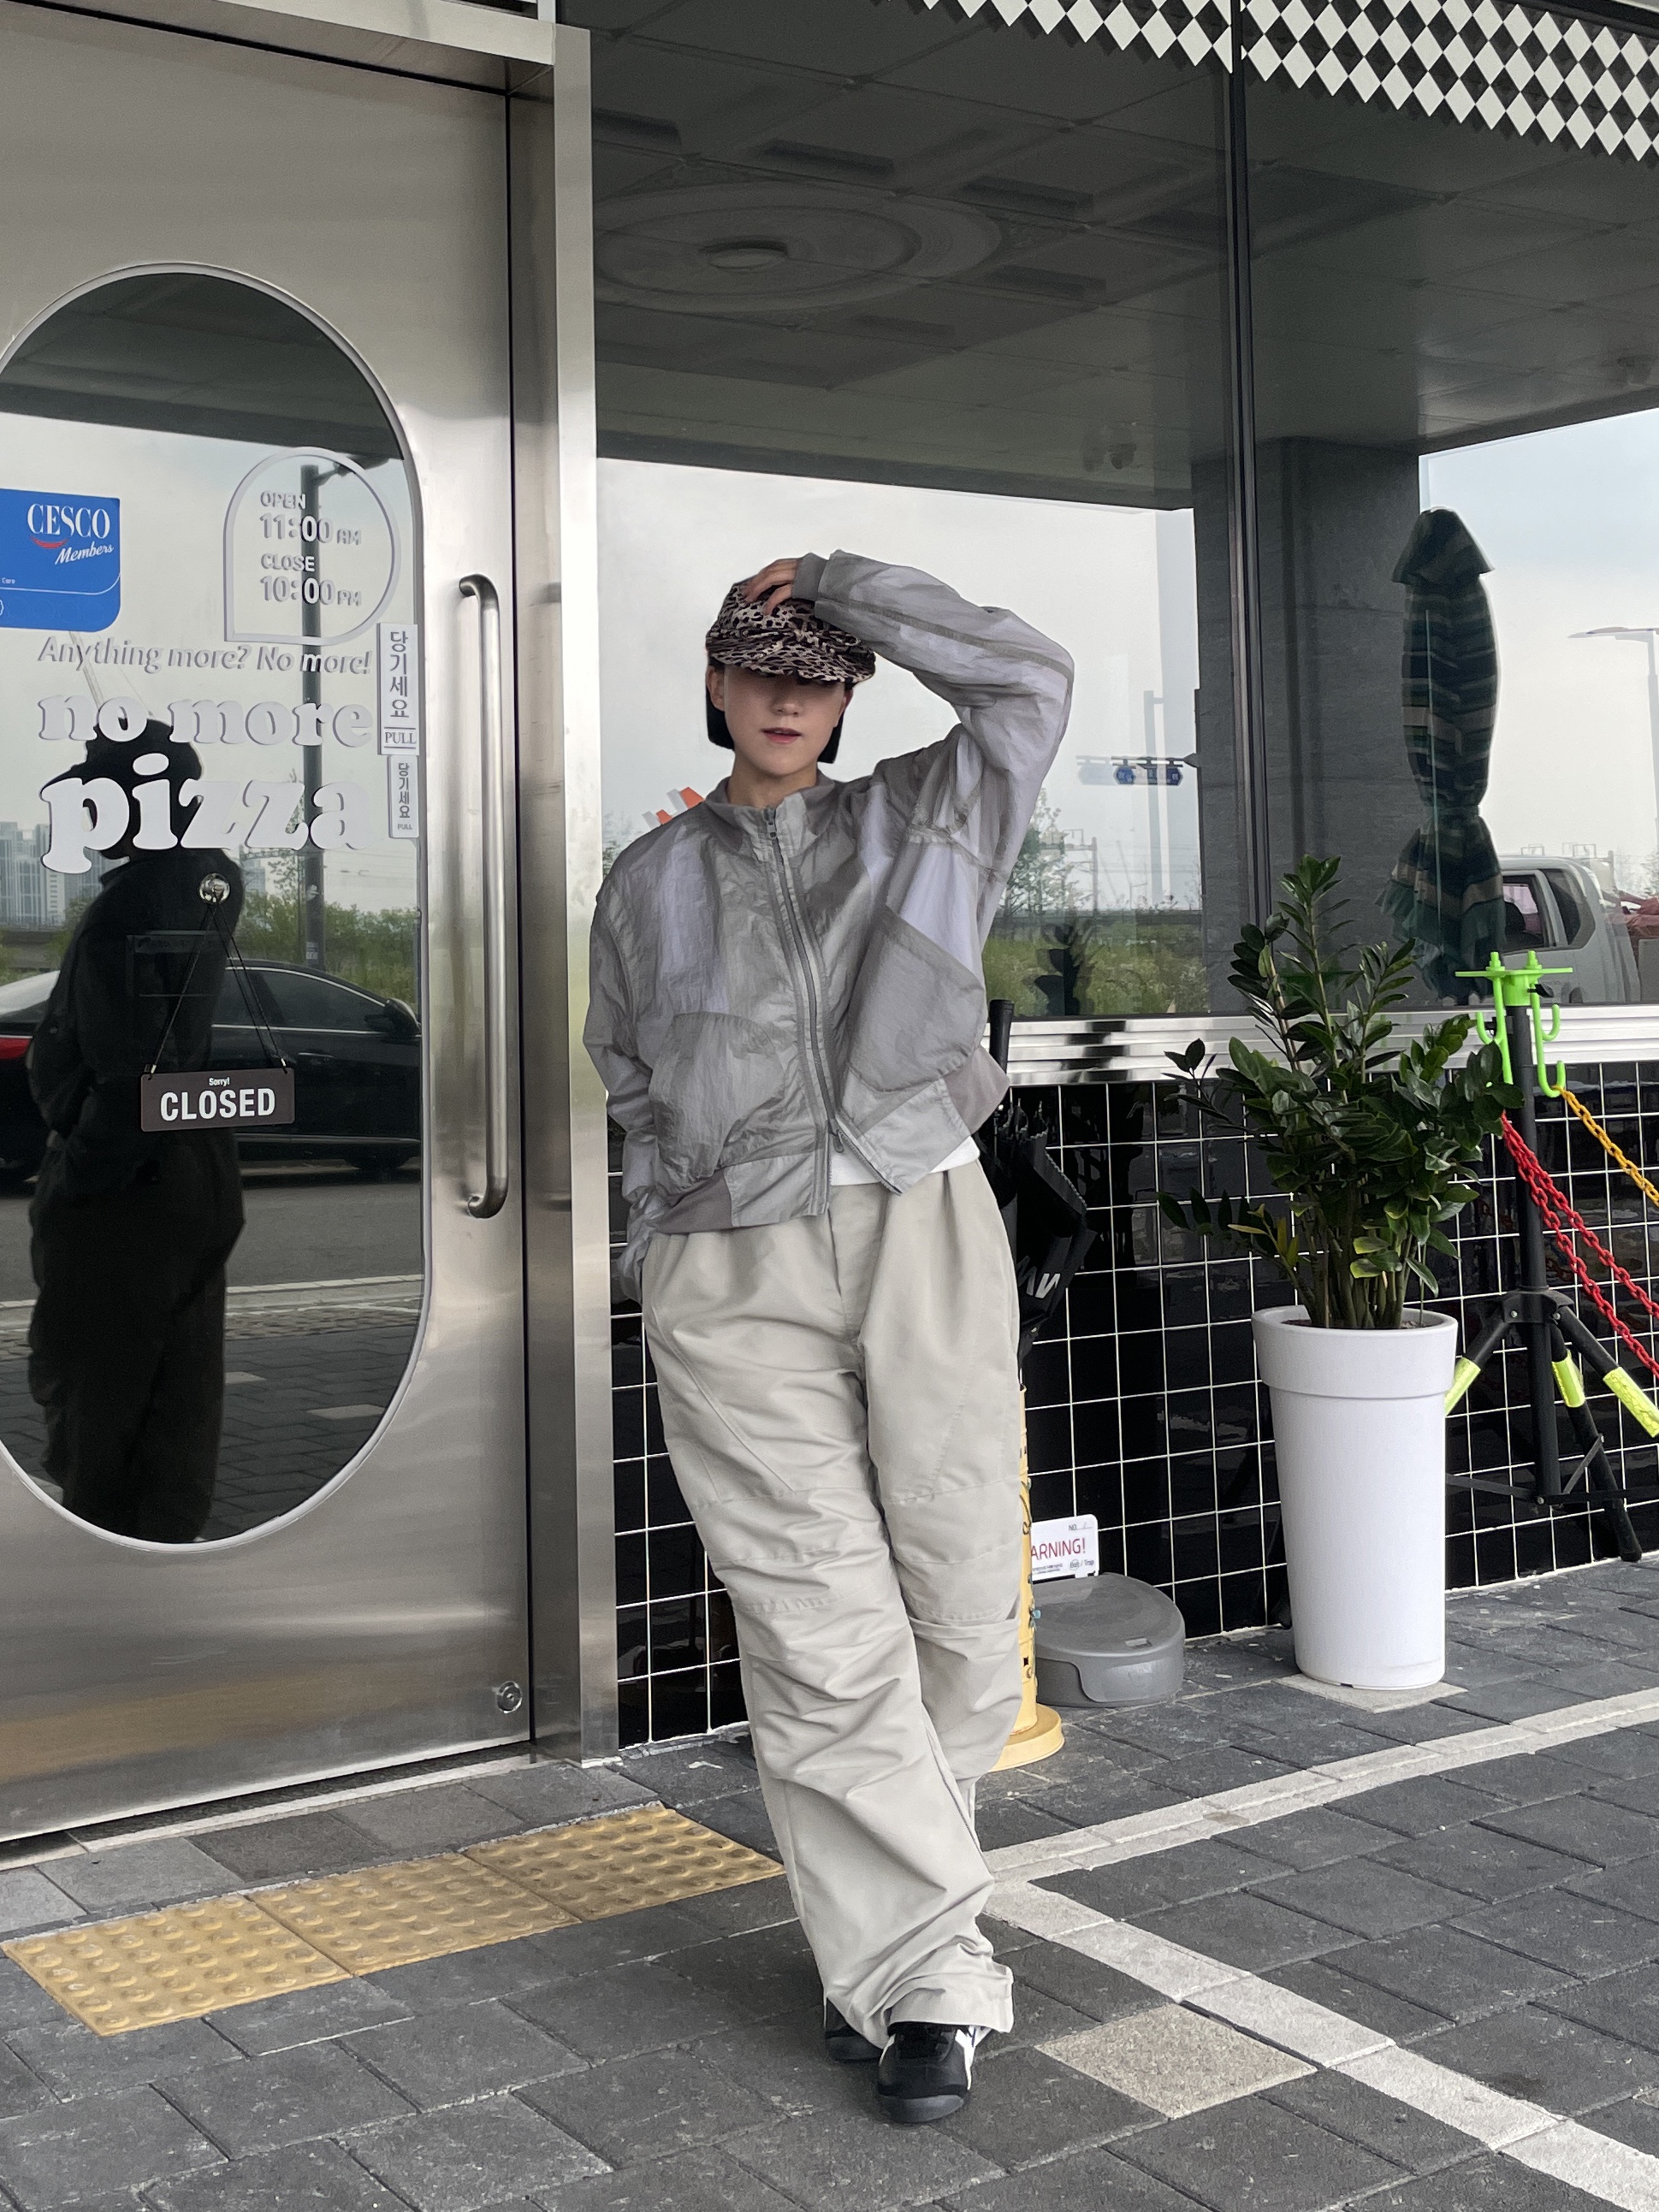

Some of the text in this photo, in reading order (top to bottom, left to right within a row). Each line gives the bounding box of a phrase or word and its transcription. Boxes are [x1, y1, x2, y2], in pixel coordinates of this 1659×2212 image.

[260, 490, 306, 509] OPEN
[27, 503, 110, 539] CESCO
[259, 512, 362, 546] 11:00 AM
[54, 541, 114, 565] Members
[260, 553, 316, 572] CLOSE
[259, 575, 363, 606] 10:00 PM
[37, 636, 374, 676] Anything more? No more!
[389, 630, 410, 718] 당기세요
[37, 694, 374, 748] no more
[384, 731, 418, 745] PULL
[397, 762, 412, 819] 당기세요
[39, 752, 375, 875] pizza
[209, 1076, 230, 1087] Sorry!
[160, 1087, 276, 1121] CLOSED
[1030, 1537, 1086, 1560] ARNING!
